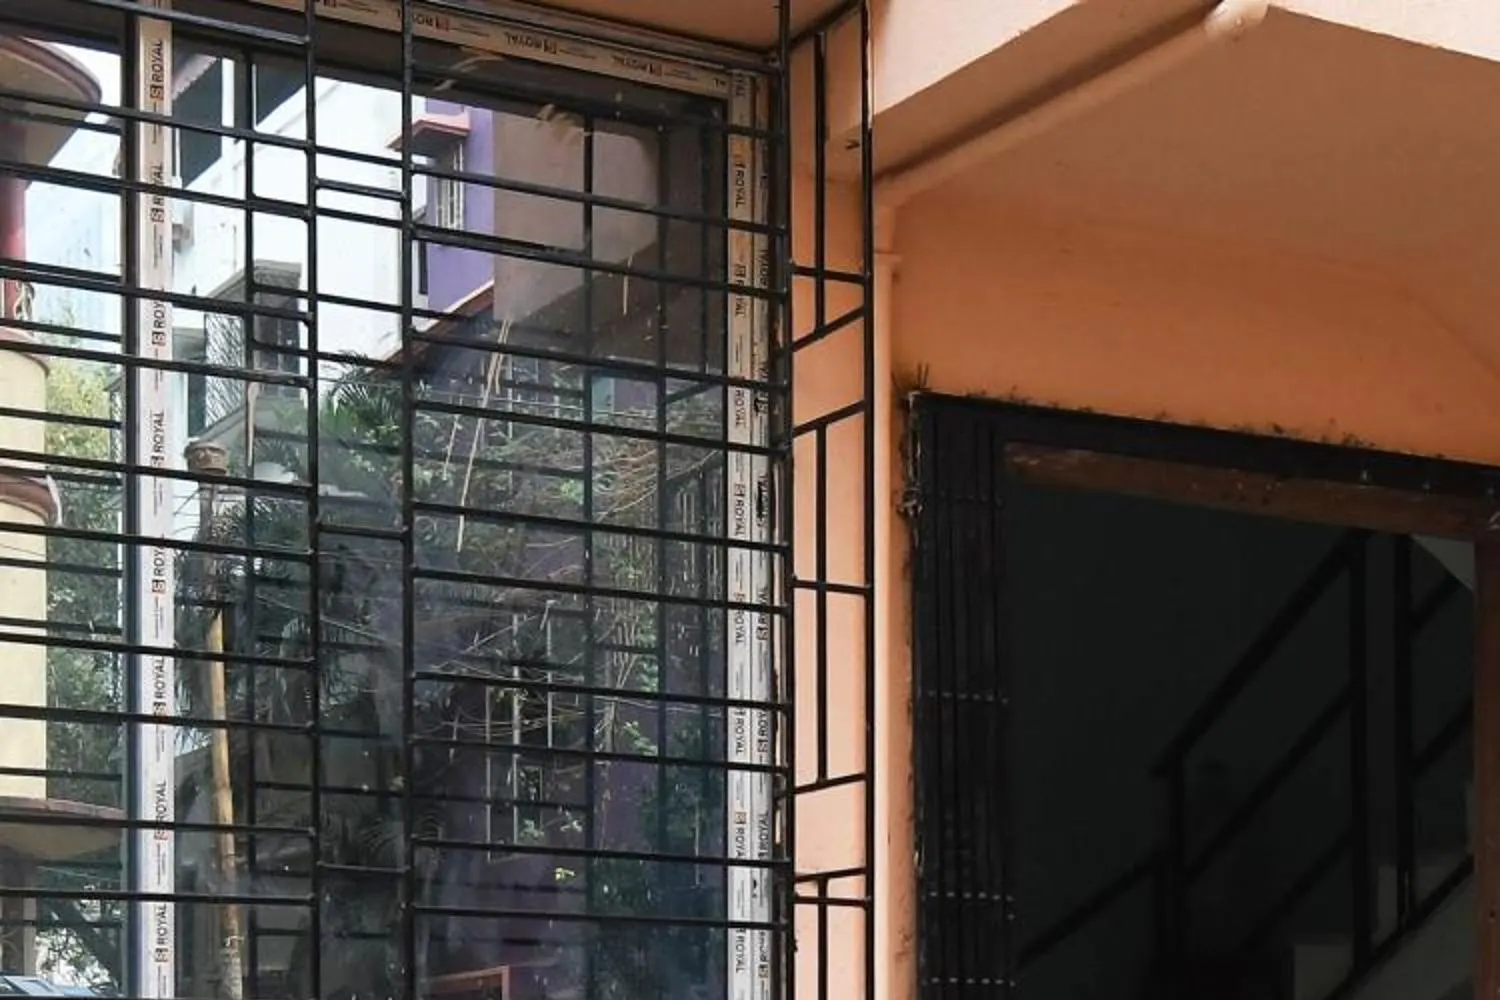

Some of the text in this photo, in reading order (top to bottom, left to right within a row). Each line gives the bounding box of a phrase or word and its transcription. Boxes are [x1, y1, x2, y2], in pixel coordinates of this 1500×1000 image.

[151, 40, 163, 83] ROYAL
[151, 163, 164, 206] RYAL
[735, 170, 745, 208] ROYAL
[736, 279, 745, 318] RYAL
[736, 389, 745, 428] ROYAL
[153, 410, 164, 453] ROYAL
[735, 499, 745, 537] ROYAL
[154, 656, 165, 699] ROYAL
[736, 717, 745, 756] ROYAL
[156, 780, 167, 822] ROYAL
[736, 827, 745, 858] ROYA
[156, 903, 167, 945] ROYAL
[736, 935, 746, 973] ROYAL
